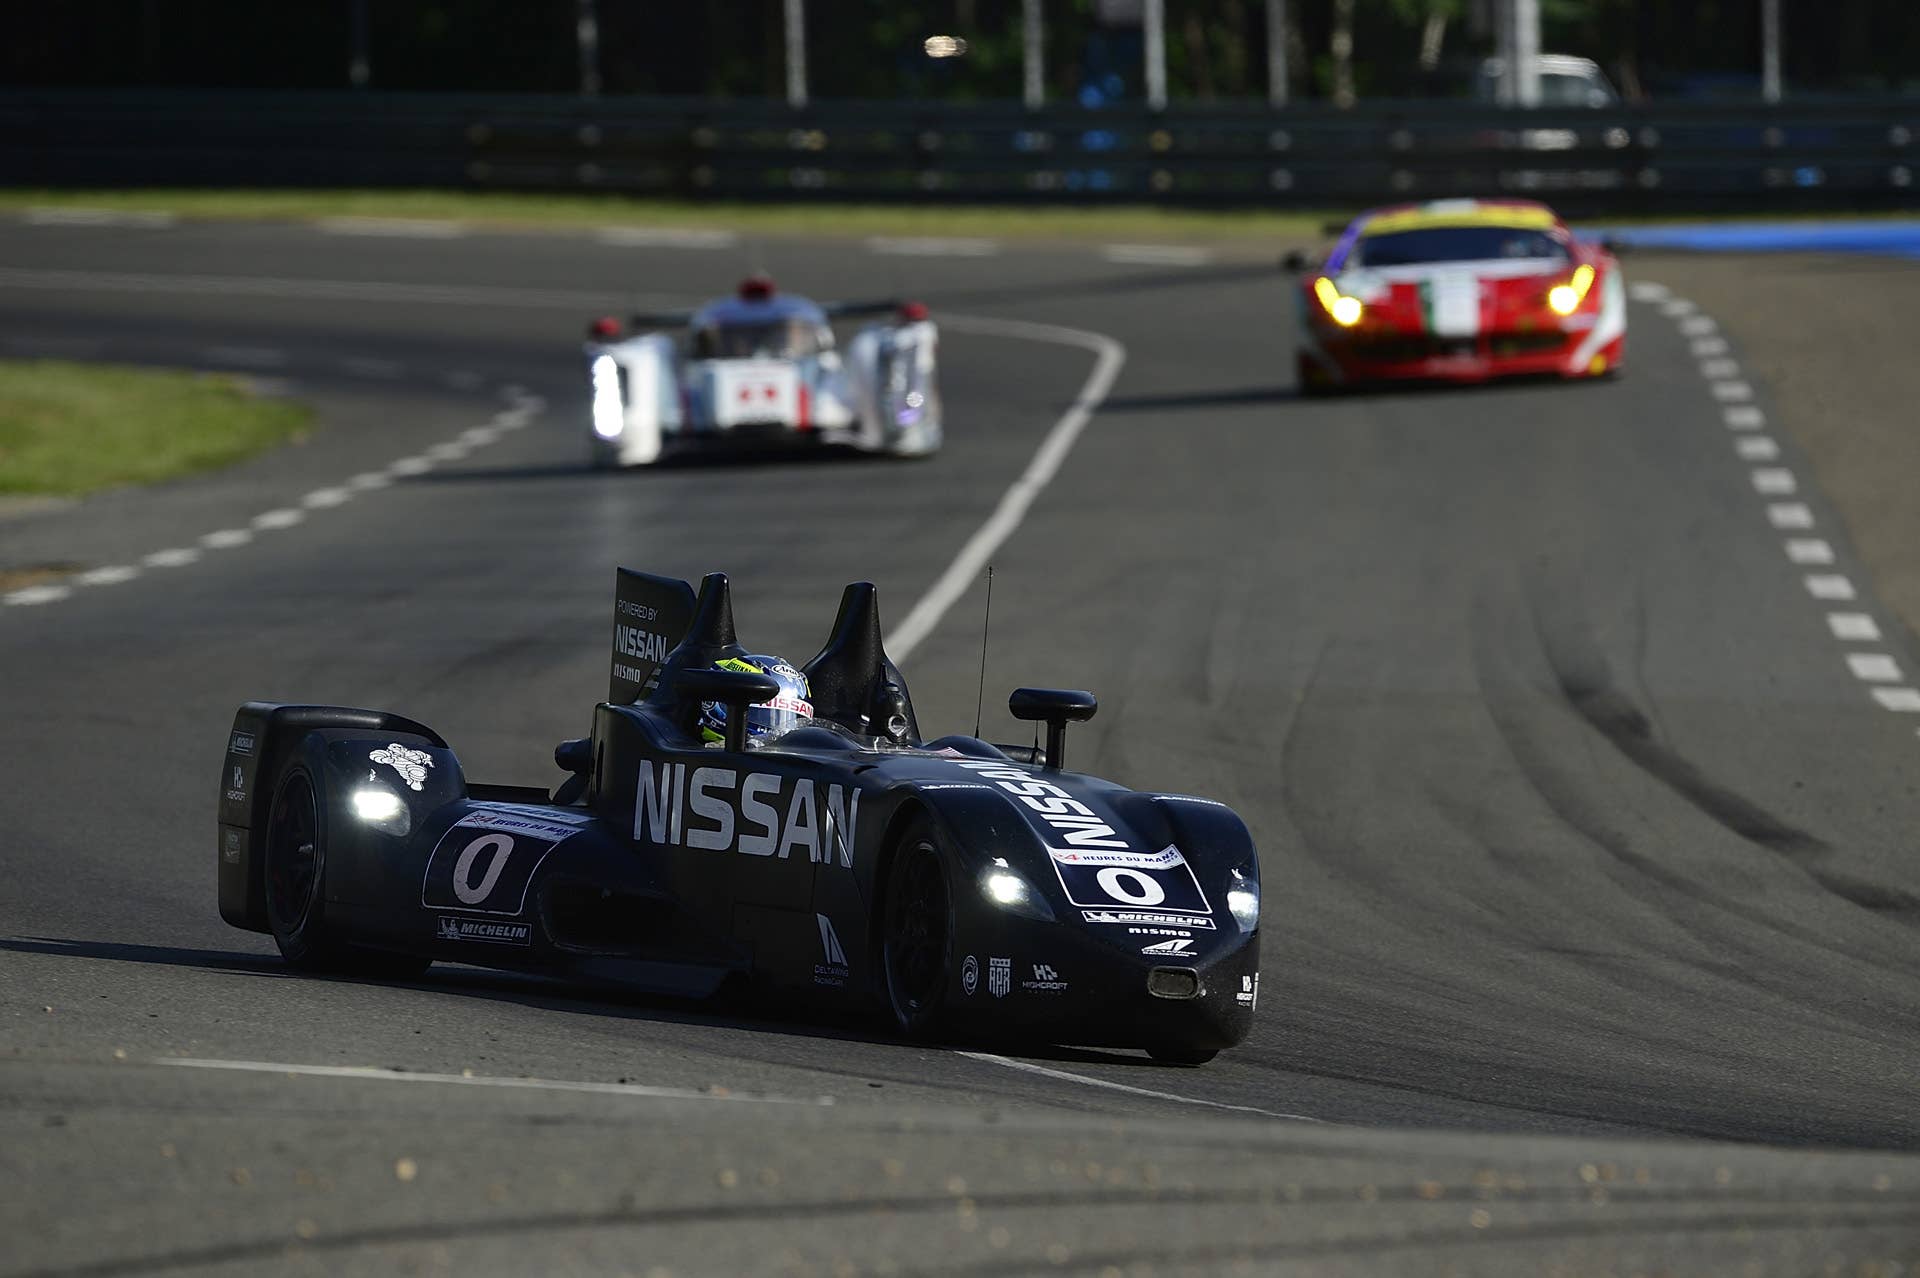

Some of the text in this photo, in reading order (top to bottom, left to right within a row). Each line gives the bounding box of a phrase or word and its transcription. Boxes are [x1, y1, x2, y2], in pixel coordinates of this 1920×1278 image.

[618, 599, 657, 620] POWERED BY
[615, 624, 666, 662] NISSAN
[760, 697, 812, 718] NISSAN
[633, 758, 861, 868] NISSAN
[943, 759, 1129, 848] NISSAN
[453, 833, 514, 904] 0
[1083, 854, 1122, 862] HEURES
[1144, 849, 1174, 862] MANS
[1096, 867, 1165, 905] 0
[460, 922, 527, 938] MICHELIN
[1117, 913, 1207, 925] MICHELIN
